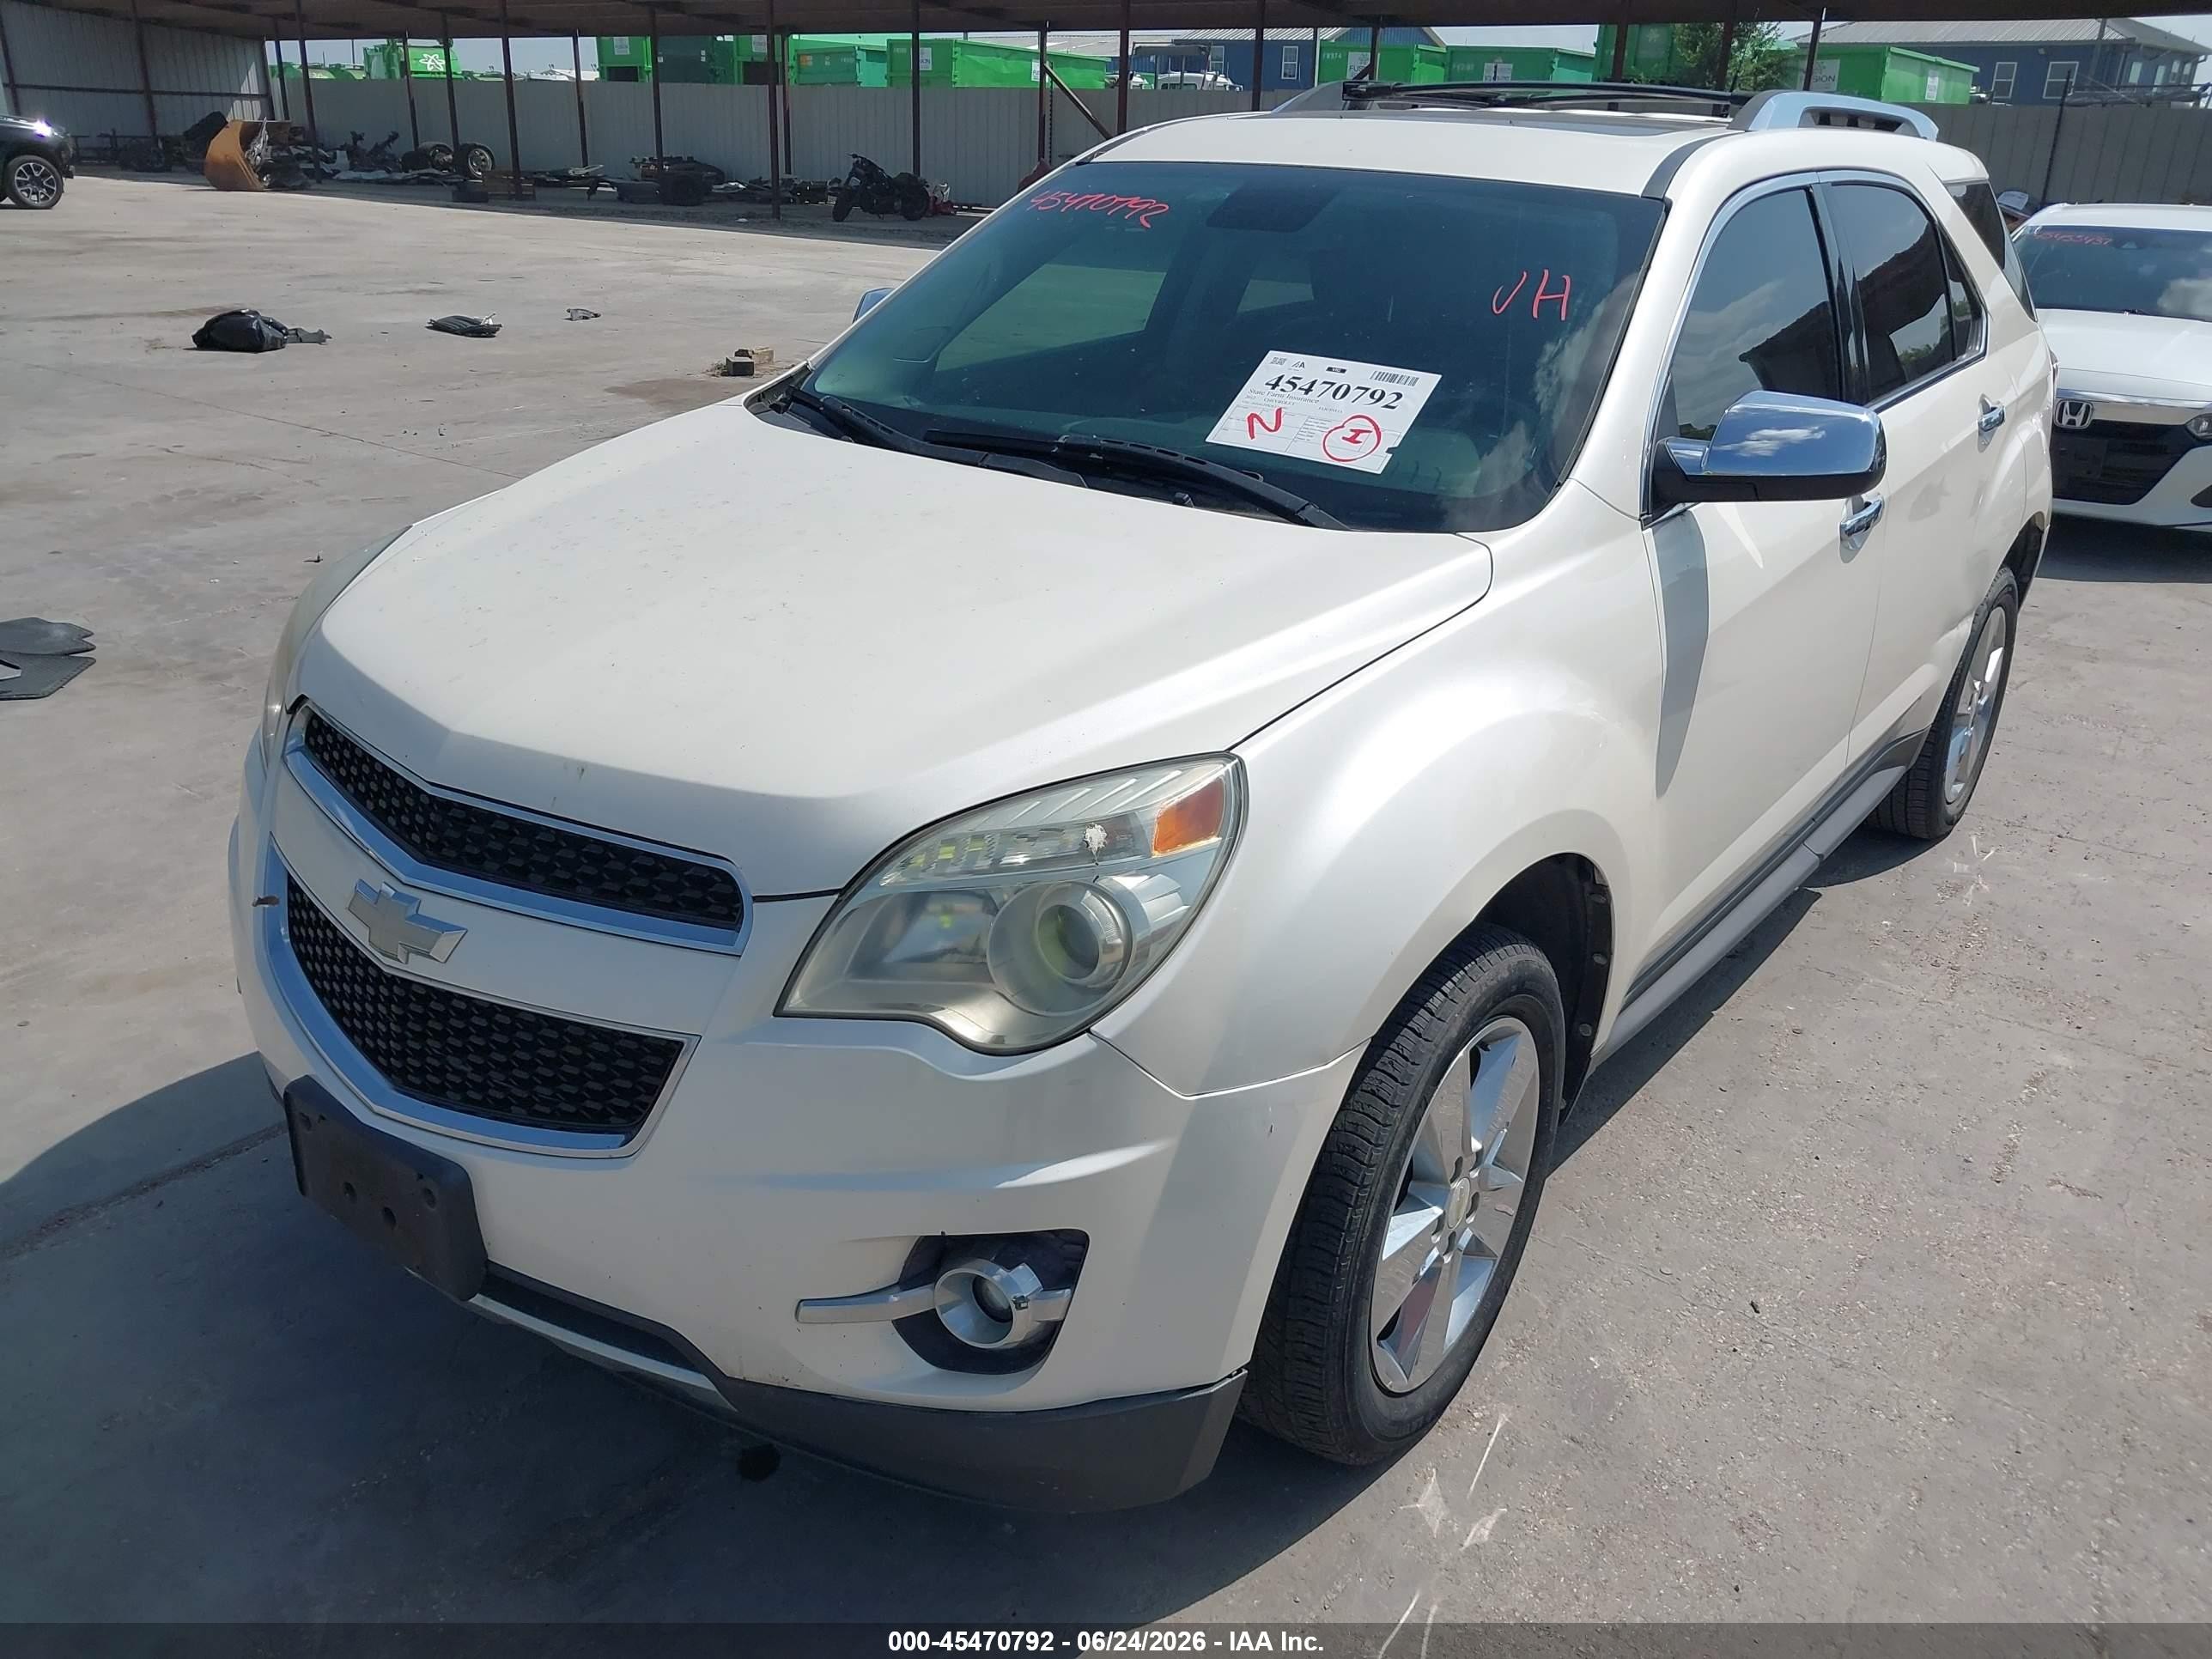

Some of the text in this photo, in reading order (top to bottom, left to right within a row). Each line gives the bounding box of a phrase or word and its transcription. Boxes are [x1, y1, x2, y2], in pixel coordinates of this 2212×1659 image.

[1264, 374, 1403, 410] 45470792
[1286, 393, 1320, 404] Insurance
[1247, 407, 1282, 440] N
